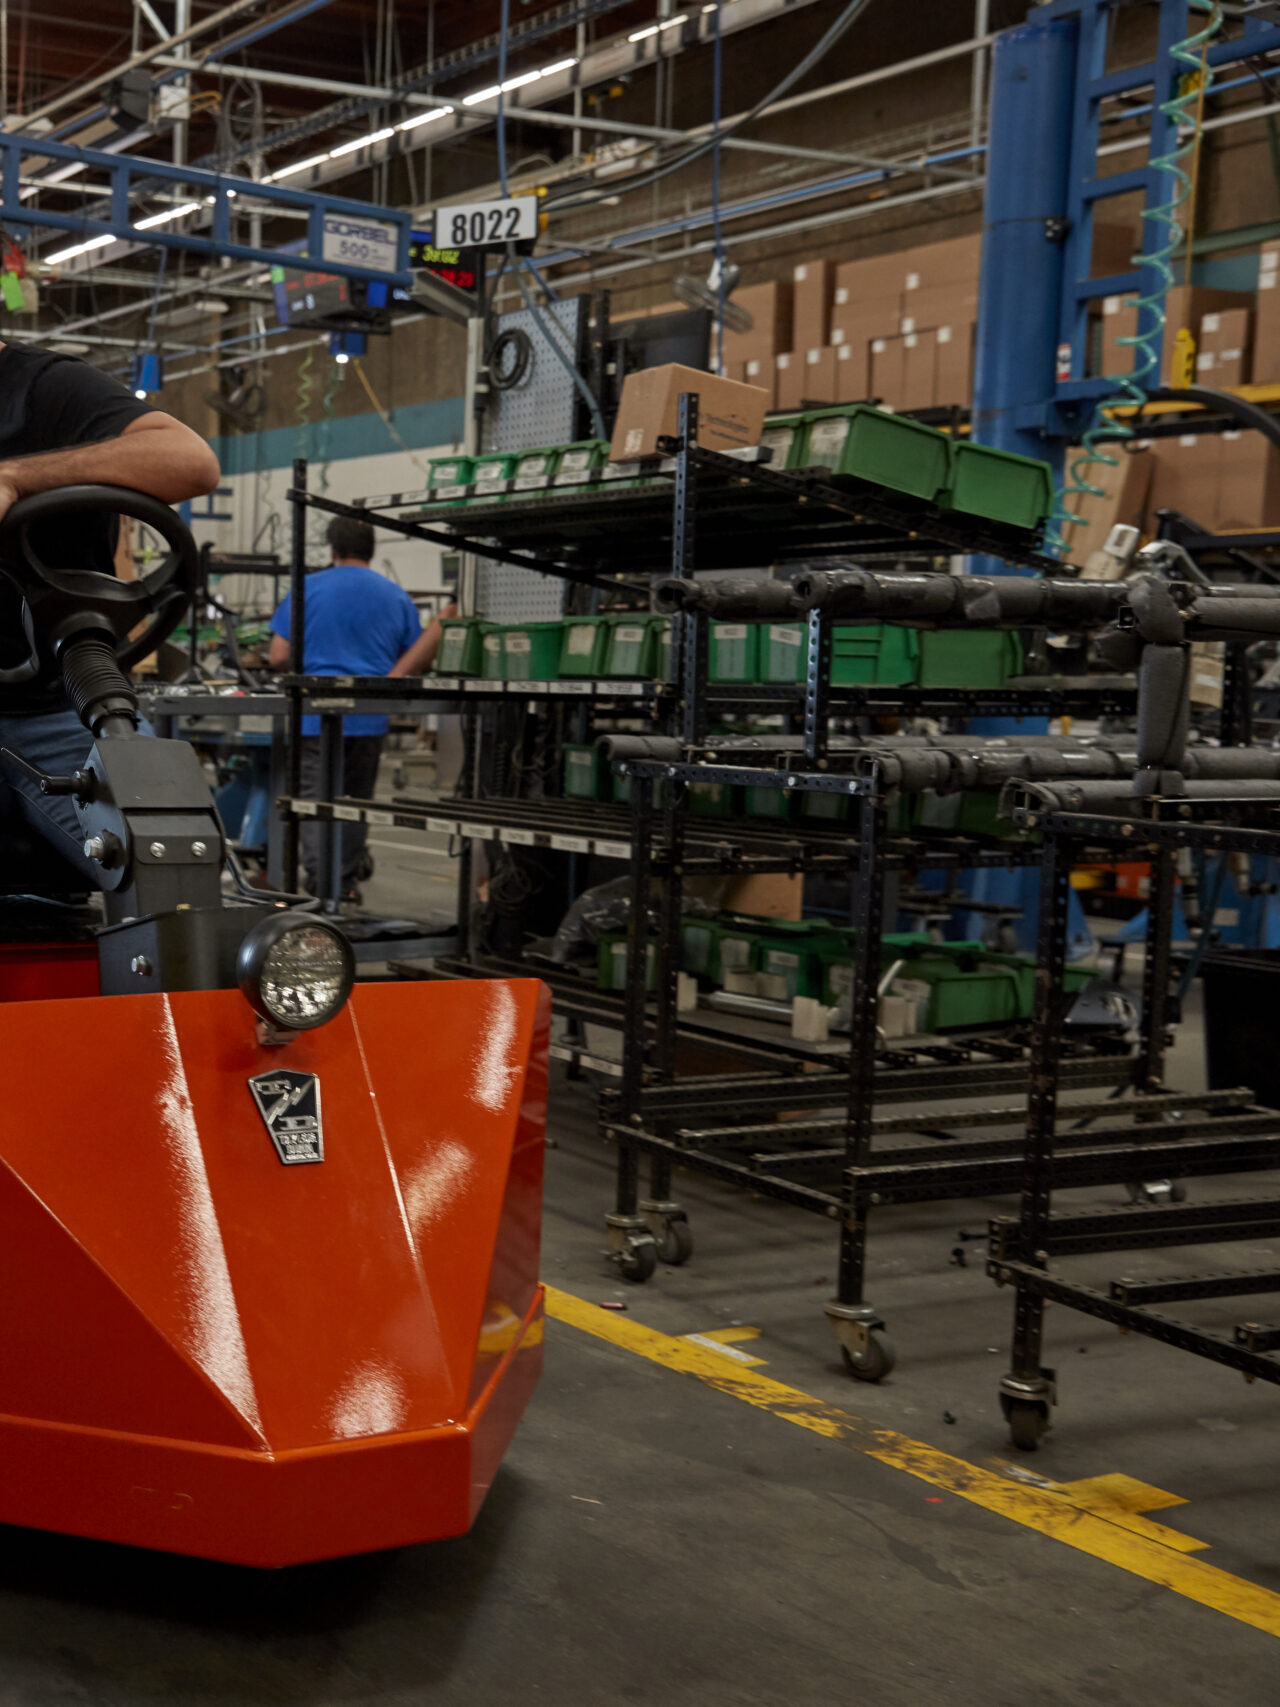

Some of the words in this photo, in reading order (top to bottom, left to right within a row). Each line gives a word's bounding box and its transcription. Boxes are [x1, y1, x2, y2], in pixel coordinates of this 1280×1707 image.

[324, 218, 398, 246] GORBEL
[451, 207, 521, 245] 8022
[340, 240, 369, 259] 500
